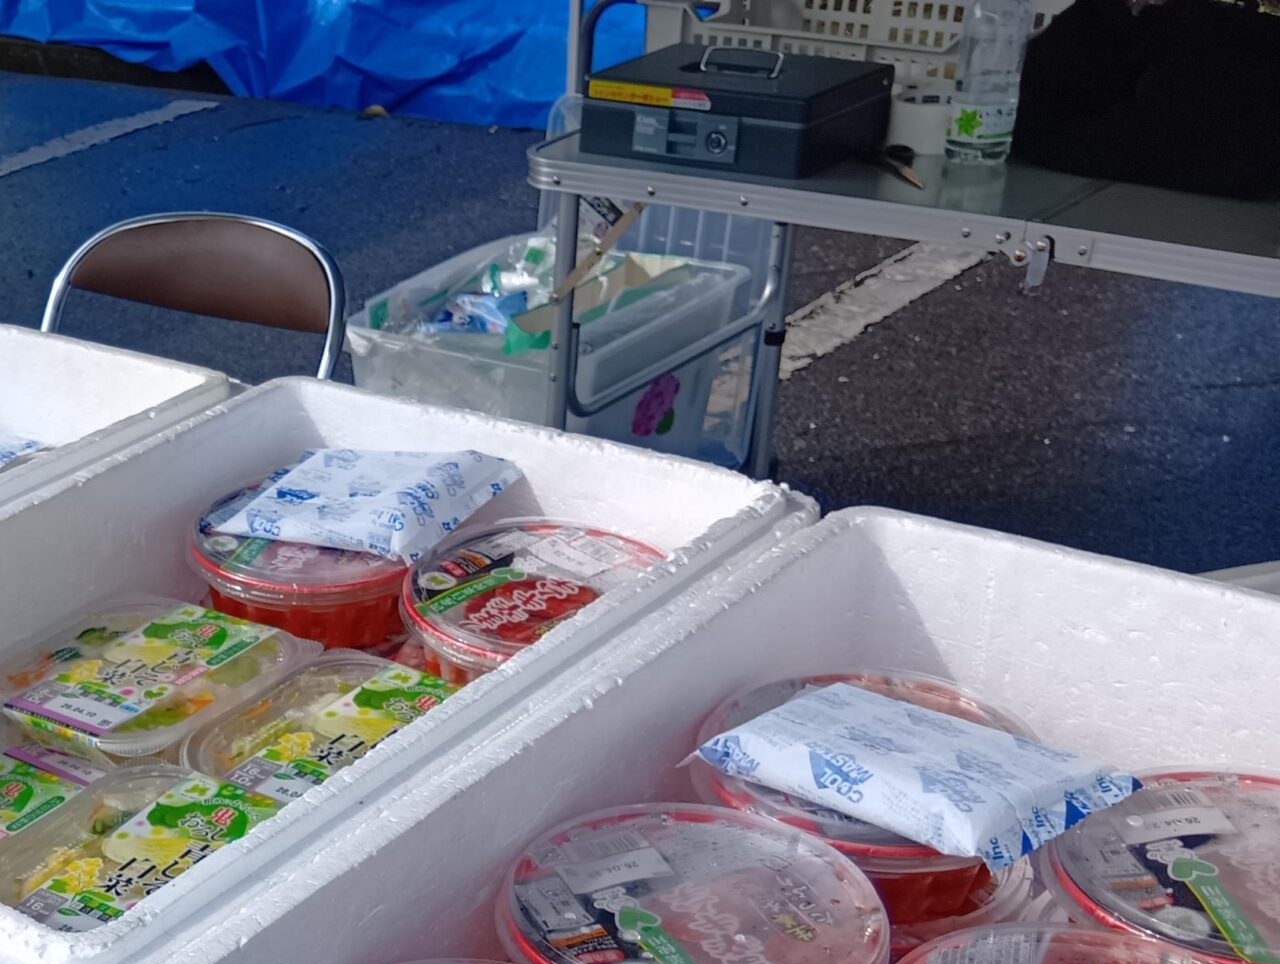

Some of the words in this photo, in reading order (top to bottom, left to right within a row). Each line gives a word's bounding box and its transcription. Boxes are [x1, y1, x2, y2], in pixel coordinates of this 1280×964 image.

[100, 658, 148, 686] 白菜
[312, 732, 366, 766] 白菜
[179, 811, 227, 842] おろし
[95, 856, 158, 897] 白菜
